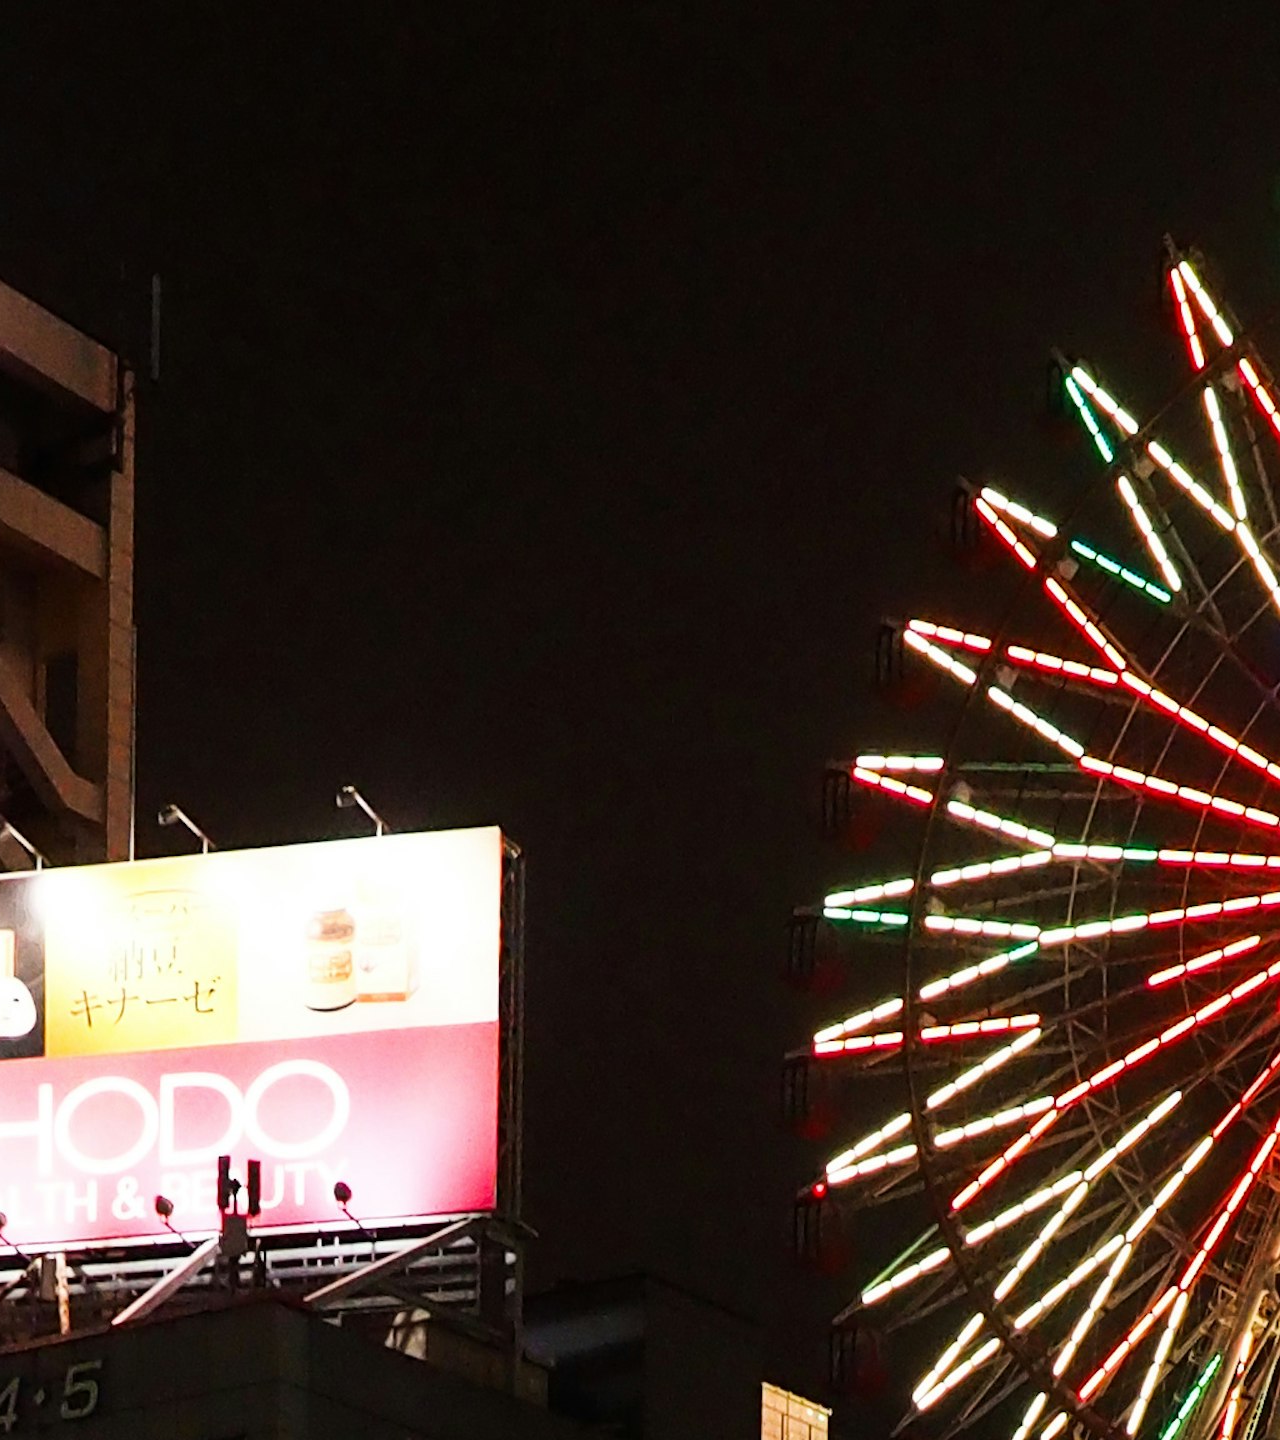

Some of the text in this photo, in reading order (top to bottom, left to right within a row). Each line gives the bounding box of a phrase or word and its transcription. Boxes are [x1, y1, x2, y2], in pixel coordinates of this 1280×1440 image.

[69, 976, 222, 1028] キナーゼ
[111, 1174, 147, 1219] &
